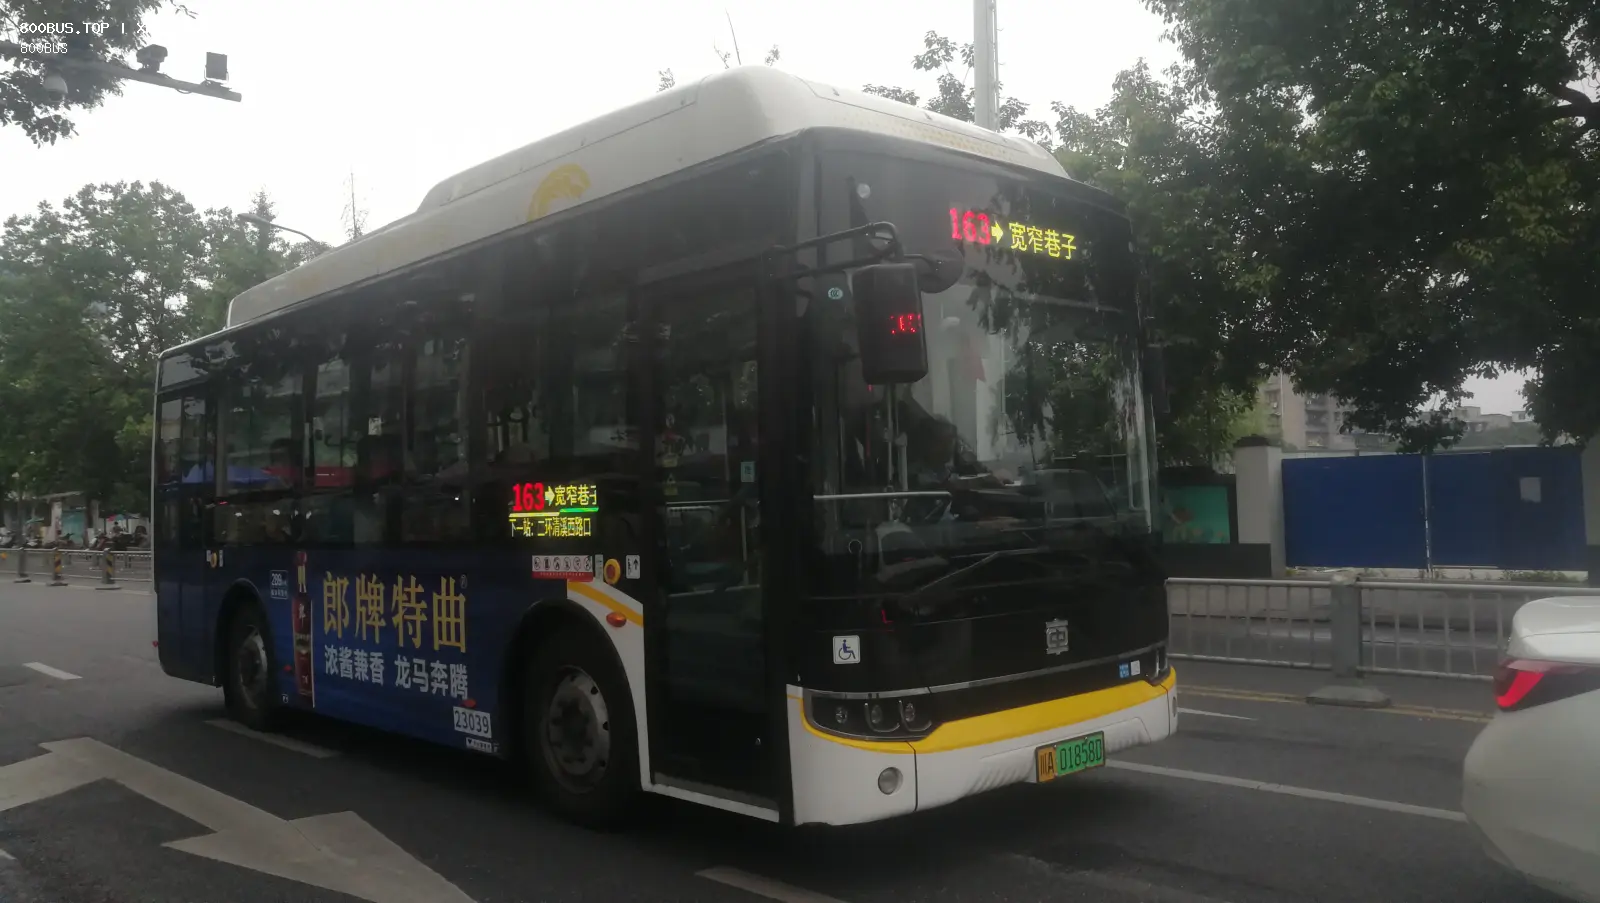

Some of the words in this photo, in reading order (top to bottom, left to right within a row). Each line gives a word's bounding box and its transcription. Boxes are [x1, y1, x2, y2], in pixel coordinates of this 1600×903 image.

[949, 207, 991, 245] 163
[1008, 221, 1077, 260] 宽窄巷子
[512, 482, 545, 512] 163
[322, 571, 467, 653] 郎牌特曲
[324, 644, 386, 686] 浓酱兼香
[394, 654, 469, 700] 龙马奔腾
[454, 710, 490, 734] 23039
